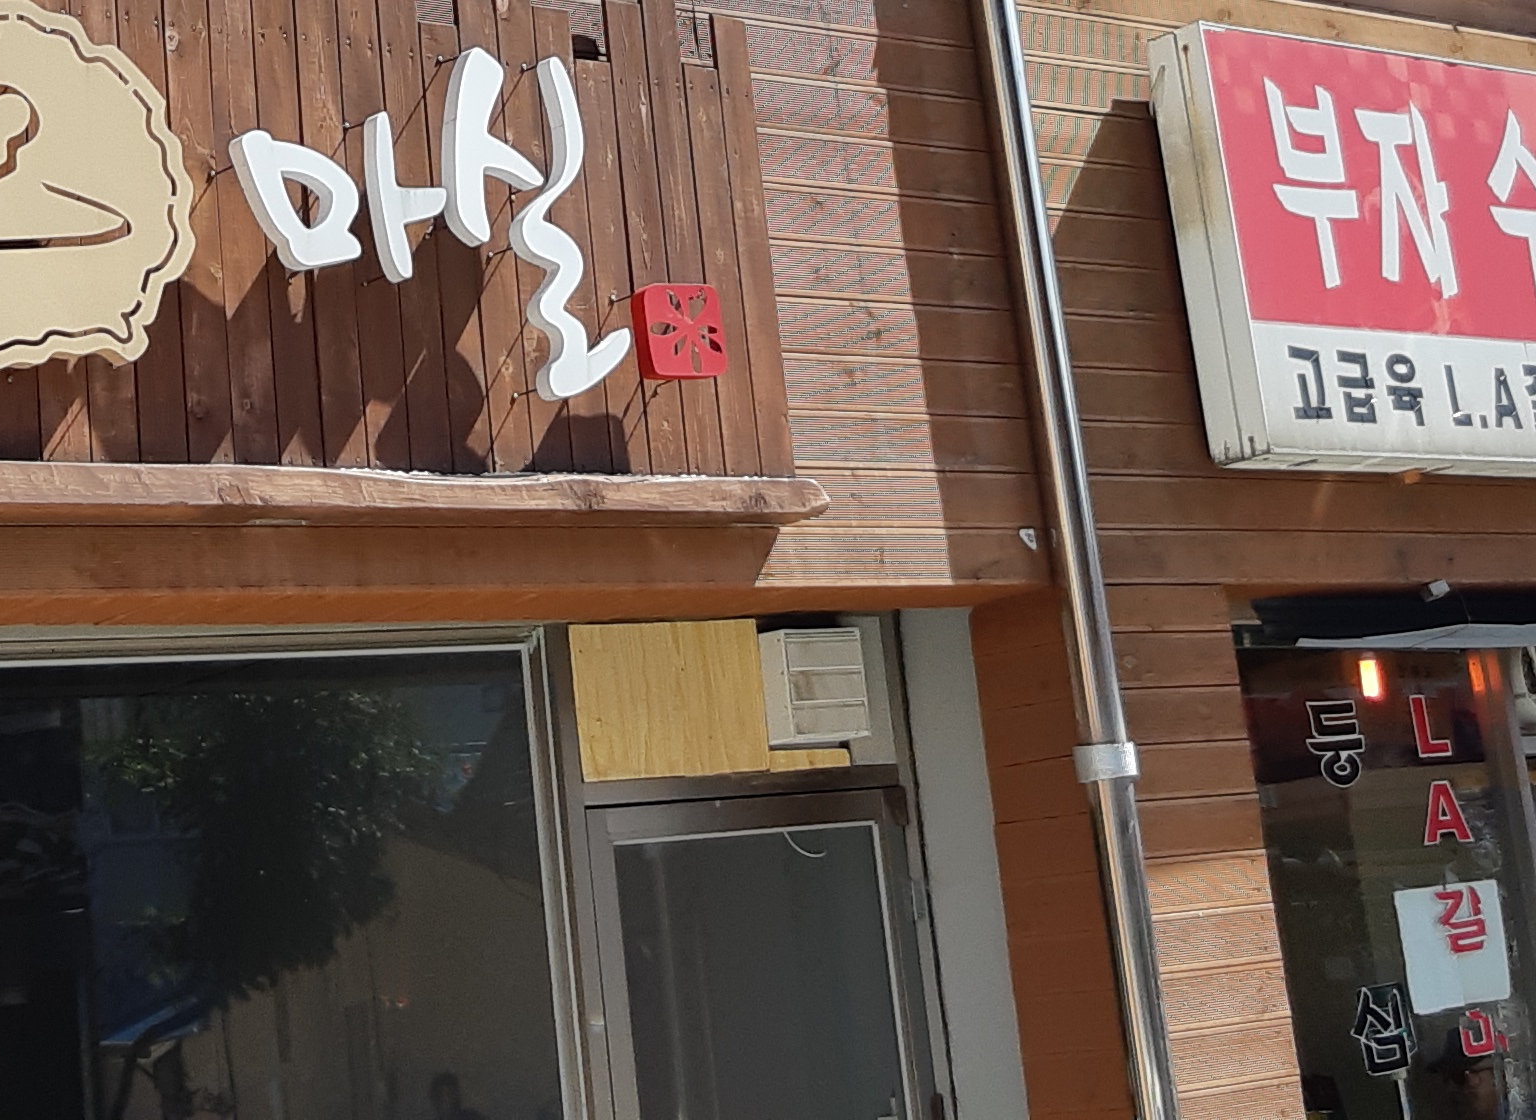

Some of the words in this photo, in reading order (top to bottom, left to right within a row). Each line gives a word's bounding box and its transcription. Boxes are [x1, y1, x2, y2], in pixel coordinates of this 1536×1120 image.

[229, 47, 632, 401] 마실
[1263, 76, 1462, 299] 부자
[1284, 344, 1426, 428] 고급육
